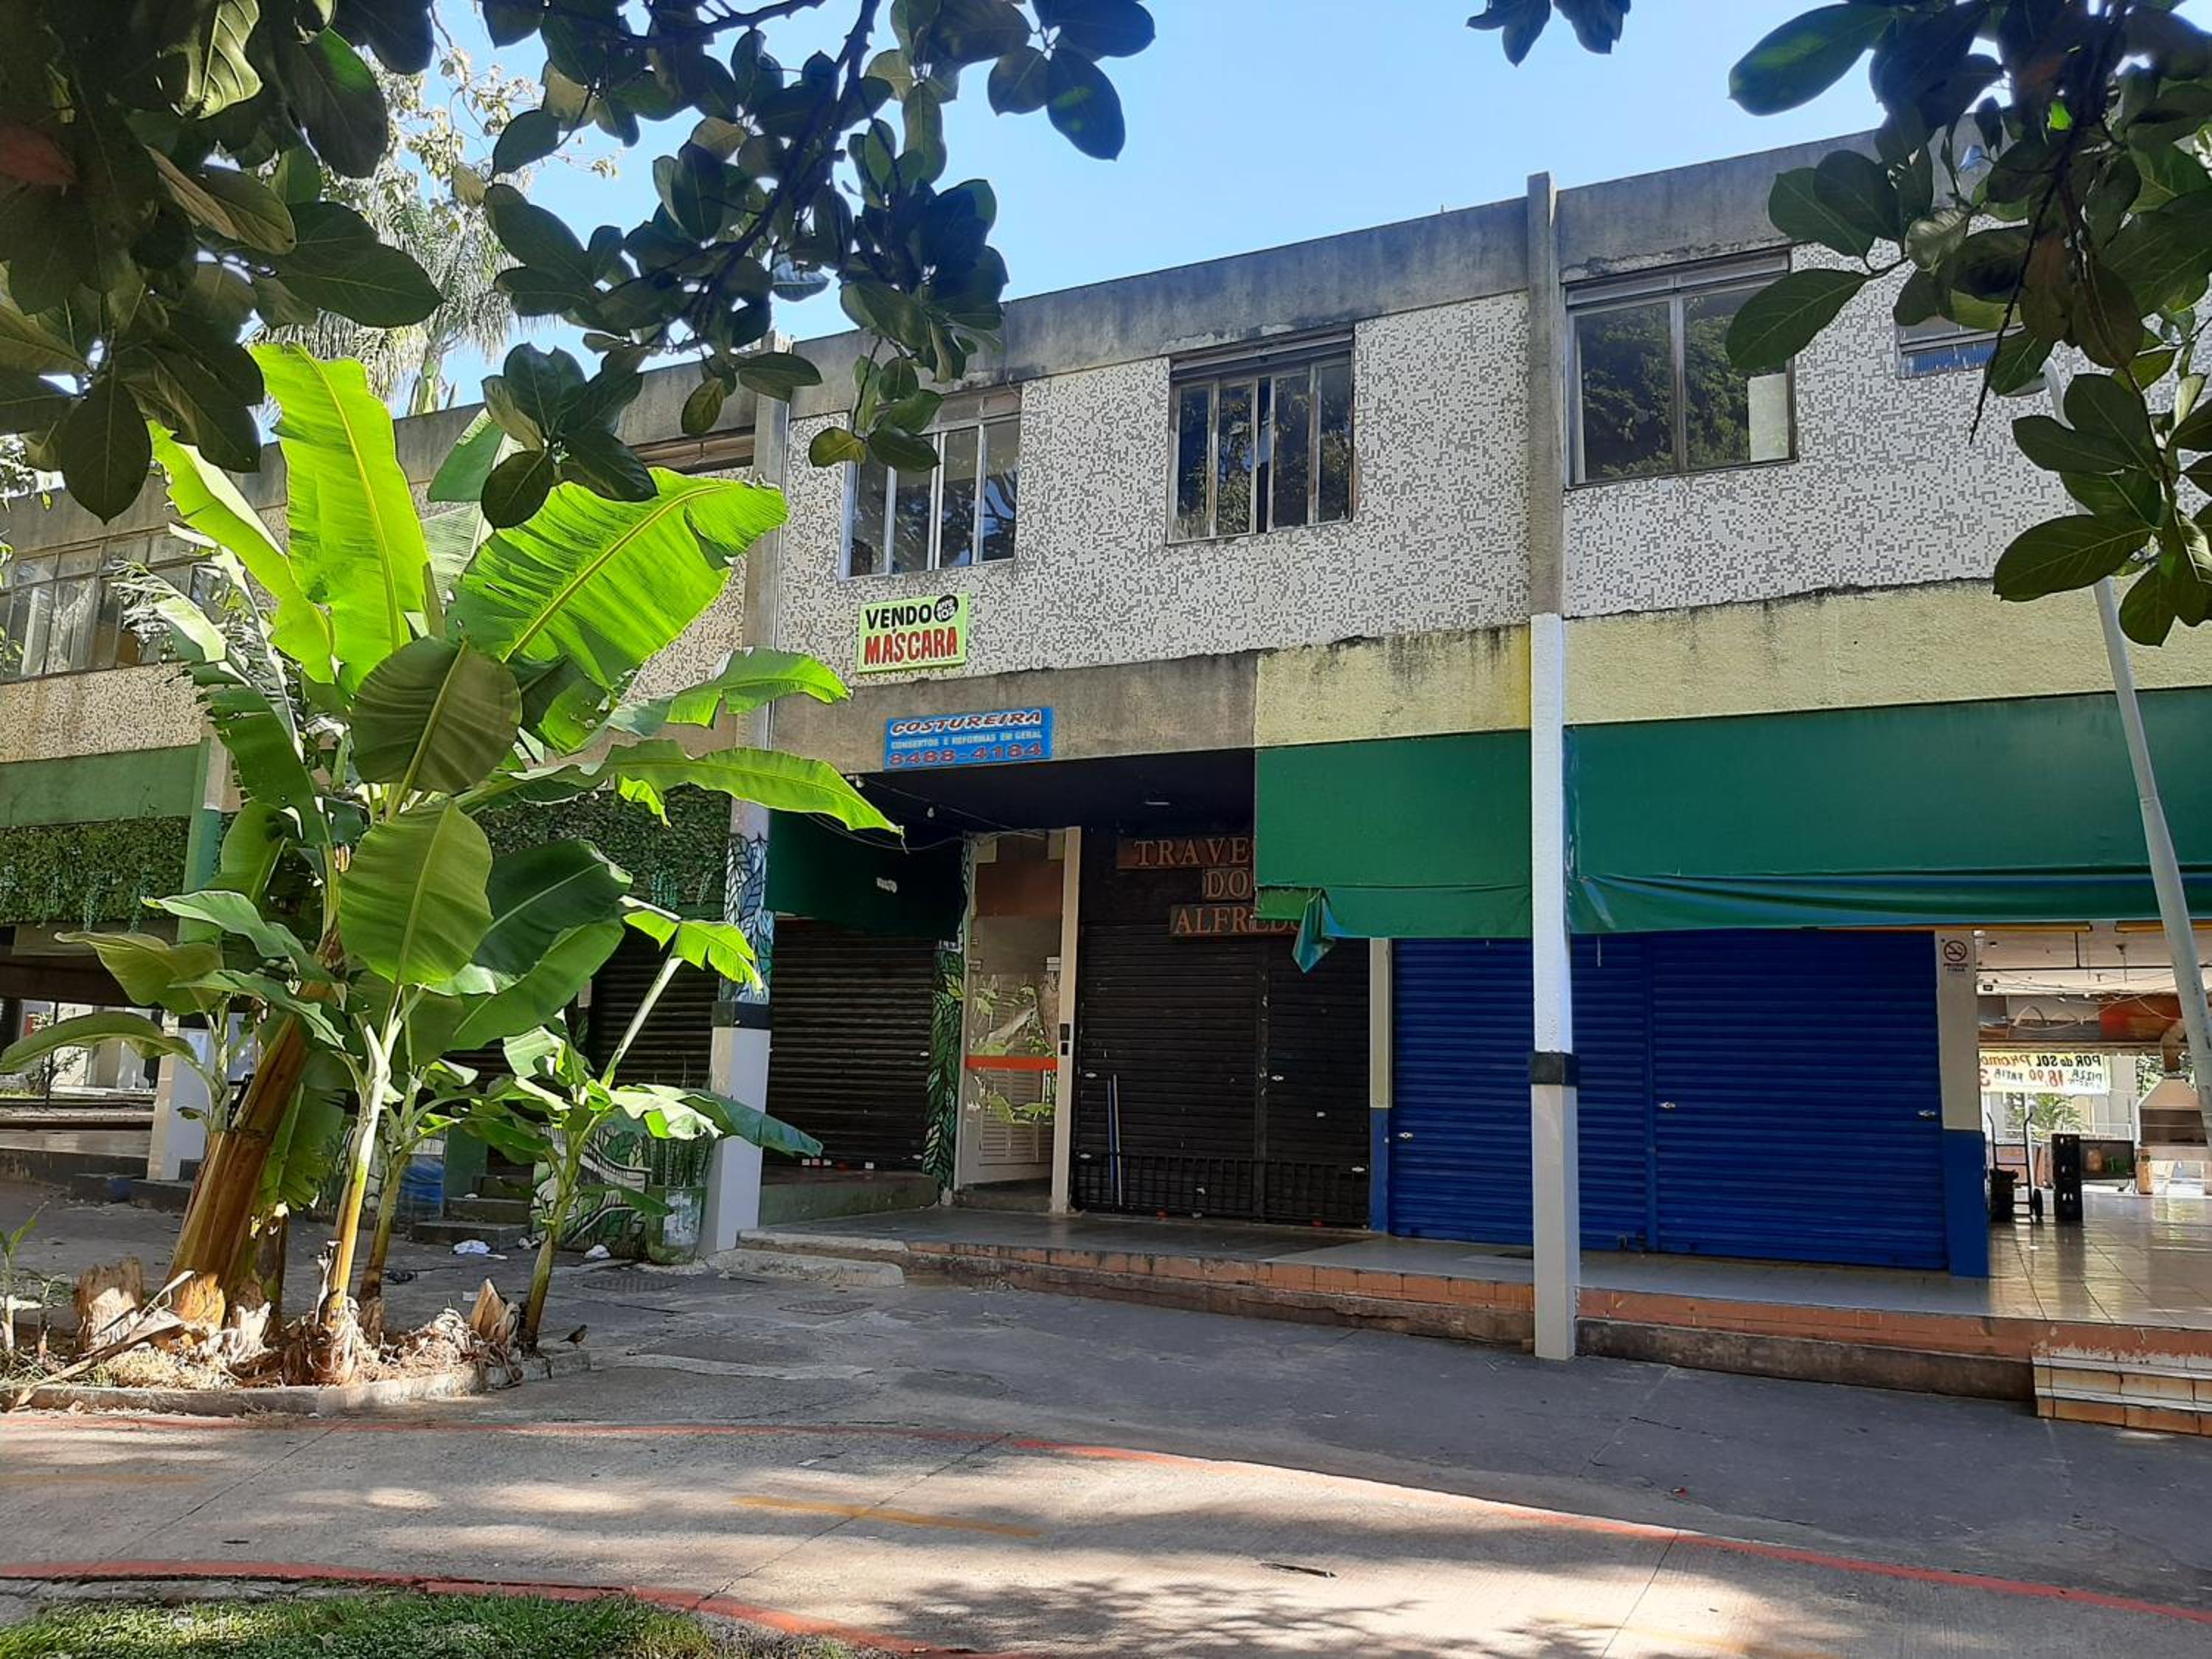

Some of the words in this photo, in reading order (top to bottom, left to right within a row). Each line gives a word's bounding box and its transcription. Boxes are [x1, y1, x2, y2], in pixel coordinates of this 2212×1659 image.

[866, 605, 931, 629] VENDO
[864, 627, 958, 664] MÁSCARA
[891, 710, 1042, 736] COSTUREIRA
[1133, 837, 1251, 866] TRAVE
[1205, 870, 1248, 897] DO
